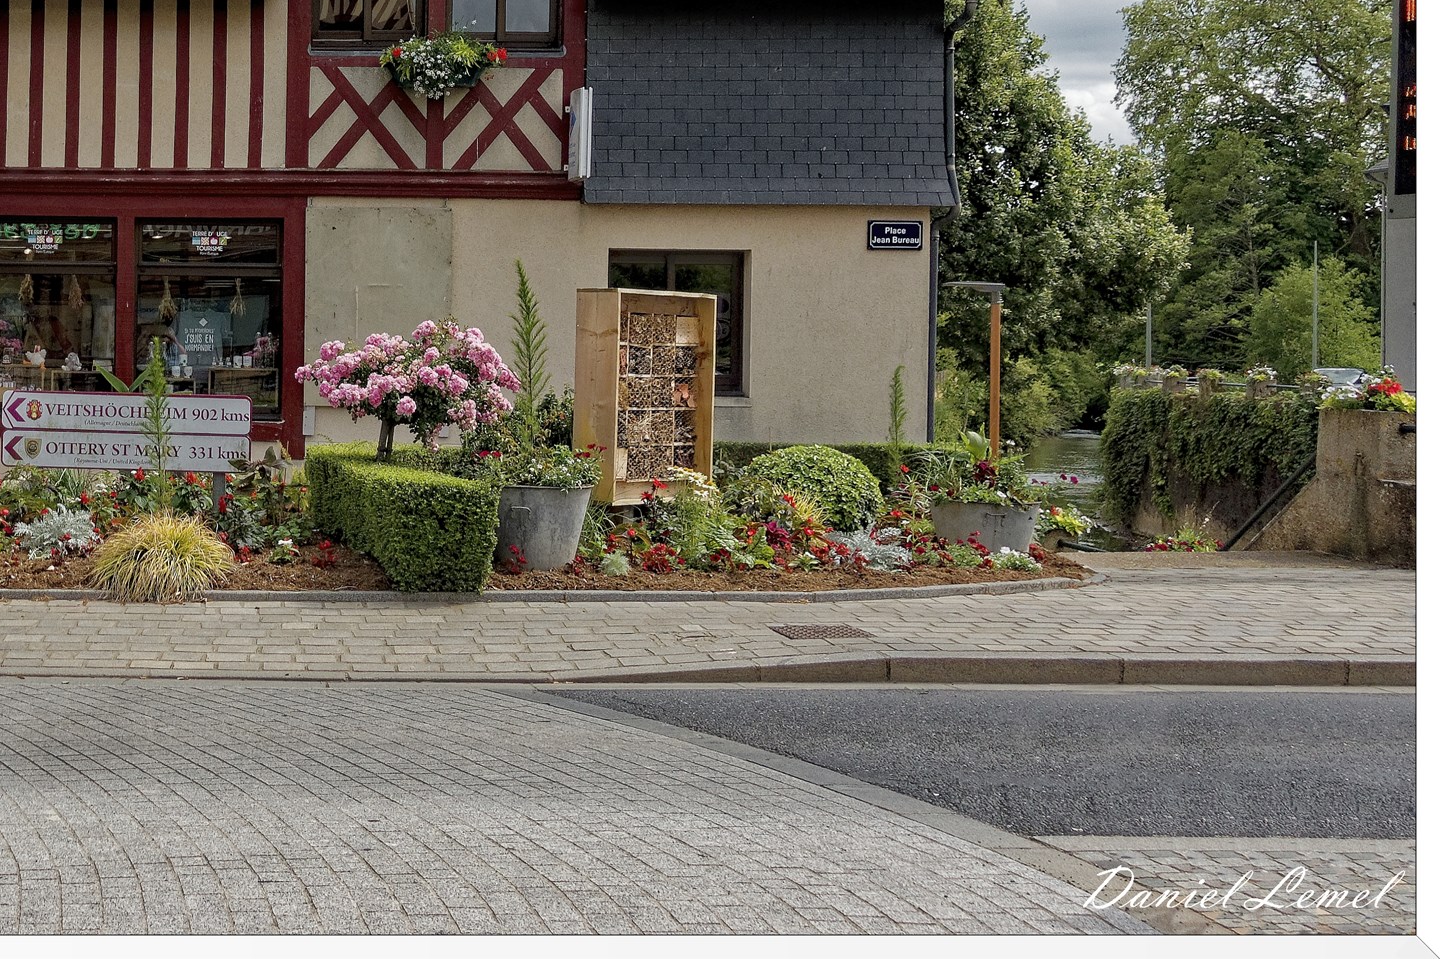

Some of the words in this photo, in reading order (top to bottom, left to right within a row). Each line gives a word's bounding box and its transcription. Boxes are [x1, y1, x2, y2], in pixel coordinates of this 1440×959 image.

[192, 408, 218, 420] 902
[221, 408, 249, 421] kms
[46, 442, 108, 455] OTTERY
[112, 444, 130, 456] ST
[135, 444, 182, 458] MARY
[189, 446, 213, 459] 331
[218, 446, 247, 460] kms
